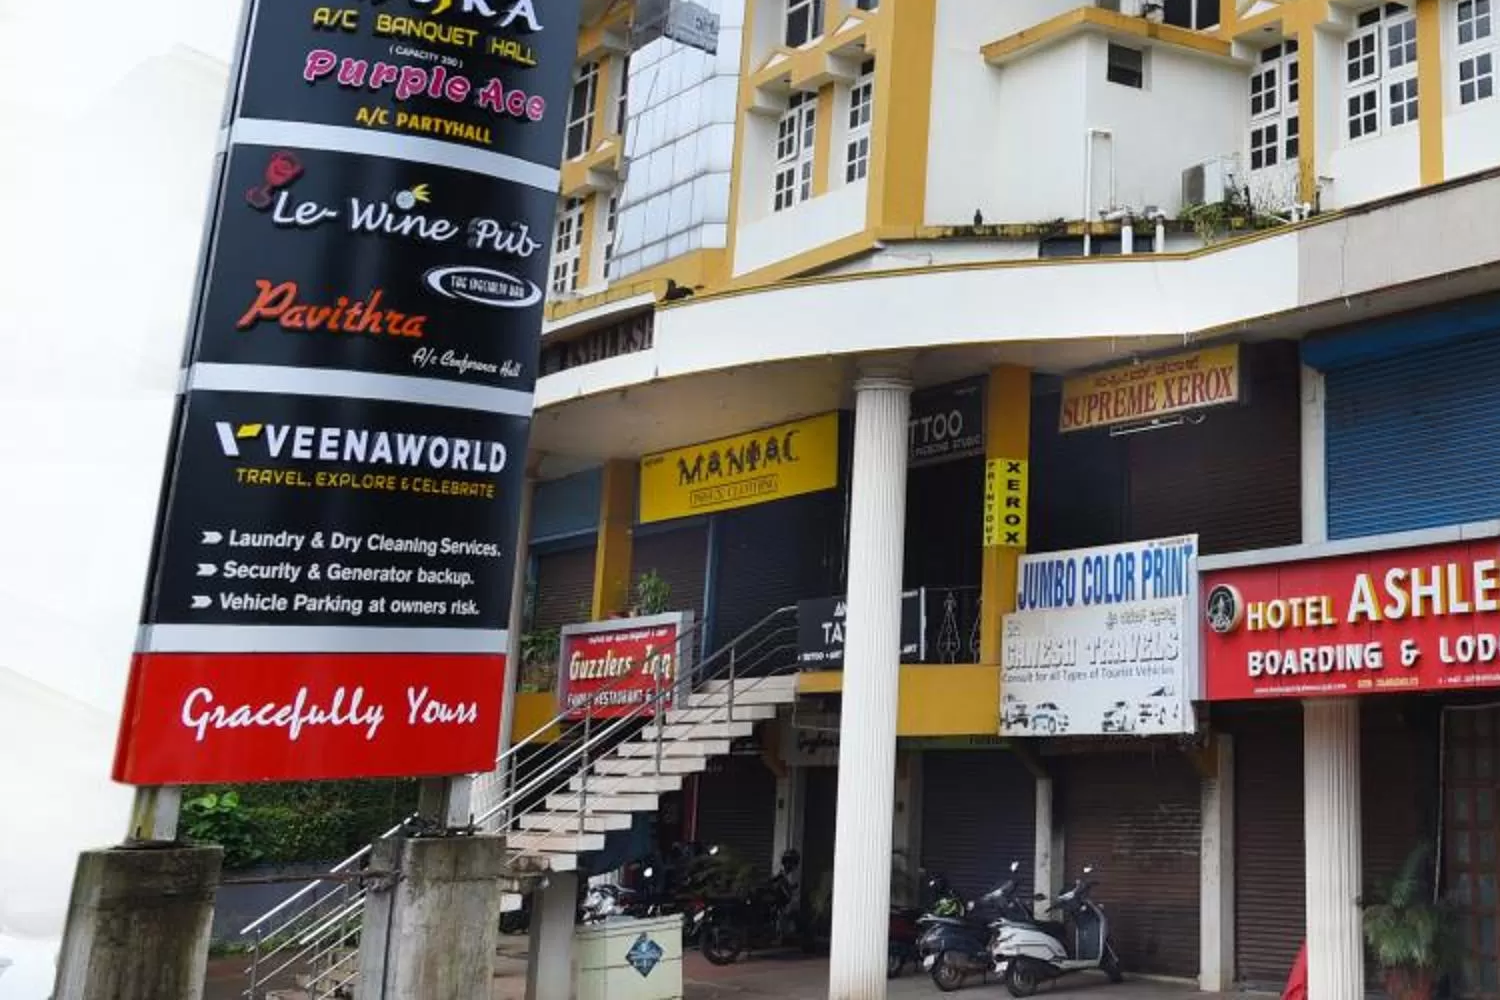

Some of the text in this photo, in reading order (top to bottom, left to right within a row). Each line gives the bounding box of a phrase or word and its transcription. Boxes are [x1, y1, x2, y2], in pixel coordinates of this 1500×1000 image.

[313, 6, 538, 66] A/C BANQUET HALL
[304, 48, 545, 122] Purple Ace
[355, 106, 493, 145] A/C PARTYHALL
[350, 190, 459, 241] Wine
[474, 218, 543, 258] Pub
[236, 279, 428, 338] Pavithra
[440, 350, 498, 375] Conference
[1063, 379, 1158, 427] SUPREME
[1162, 366, 1233, 409] XEROX
[908, 409, 963, 442] TTOO
[265, 424, 508, 473] VEENAWORLD
[677, 429, 801, 486] MANIAC
[315, 471, 396, 490] EXPLORE
[412, 478, 497, 499] CELEBRATE
[1005, 461, 1021, 543] XEROX
[228, 529, 501, 557] Laundry & Dry Cleaning Services.
[223, 560, 475, 589] Security & Generator backup.
[1018, 543, 1193, 610] JUMBO COLOR PRINT
[219, 592, 481, 616] Vehicle Parking at owners risk.
[1246, 595, 1338, 632] HOTEL
[569, 649, 633, 681] Guzzlers
[1003, 669, 1033, 683] Consult
[1035, 668, 1047, 682] for
[1049, 669, 1060, 681] all
[1062, 669, 1088, 683] Types
[1090, 667, 1100, 679] of
[1101, 666, 1134, 679] Tourist
[1247, 641, 1384, 677] BOARDING
[1400, 639, 1421, 668] &
[182, 685, 478, 741] Gracefully Yours
